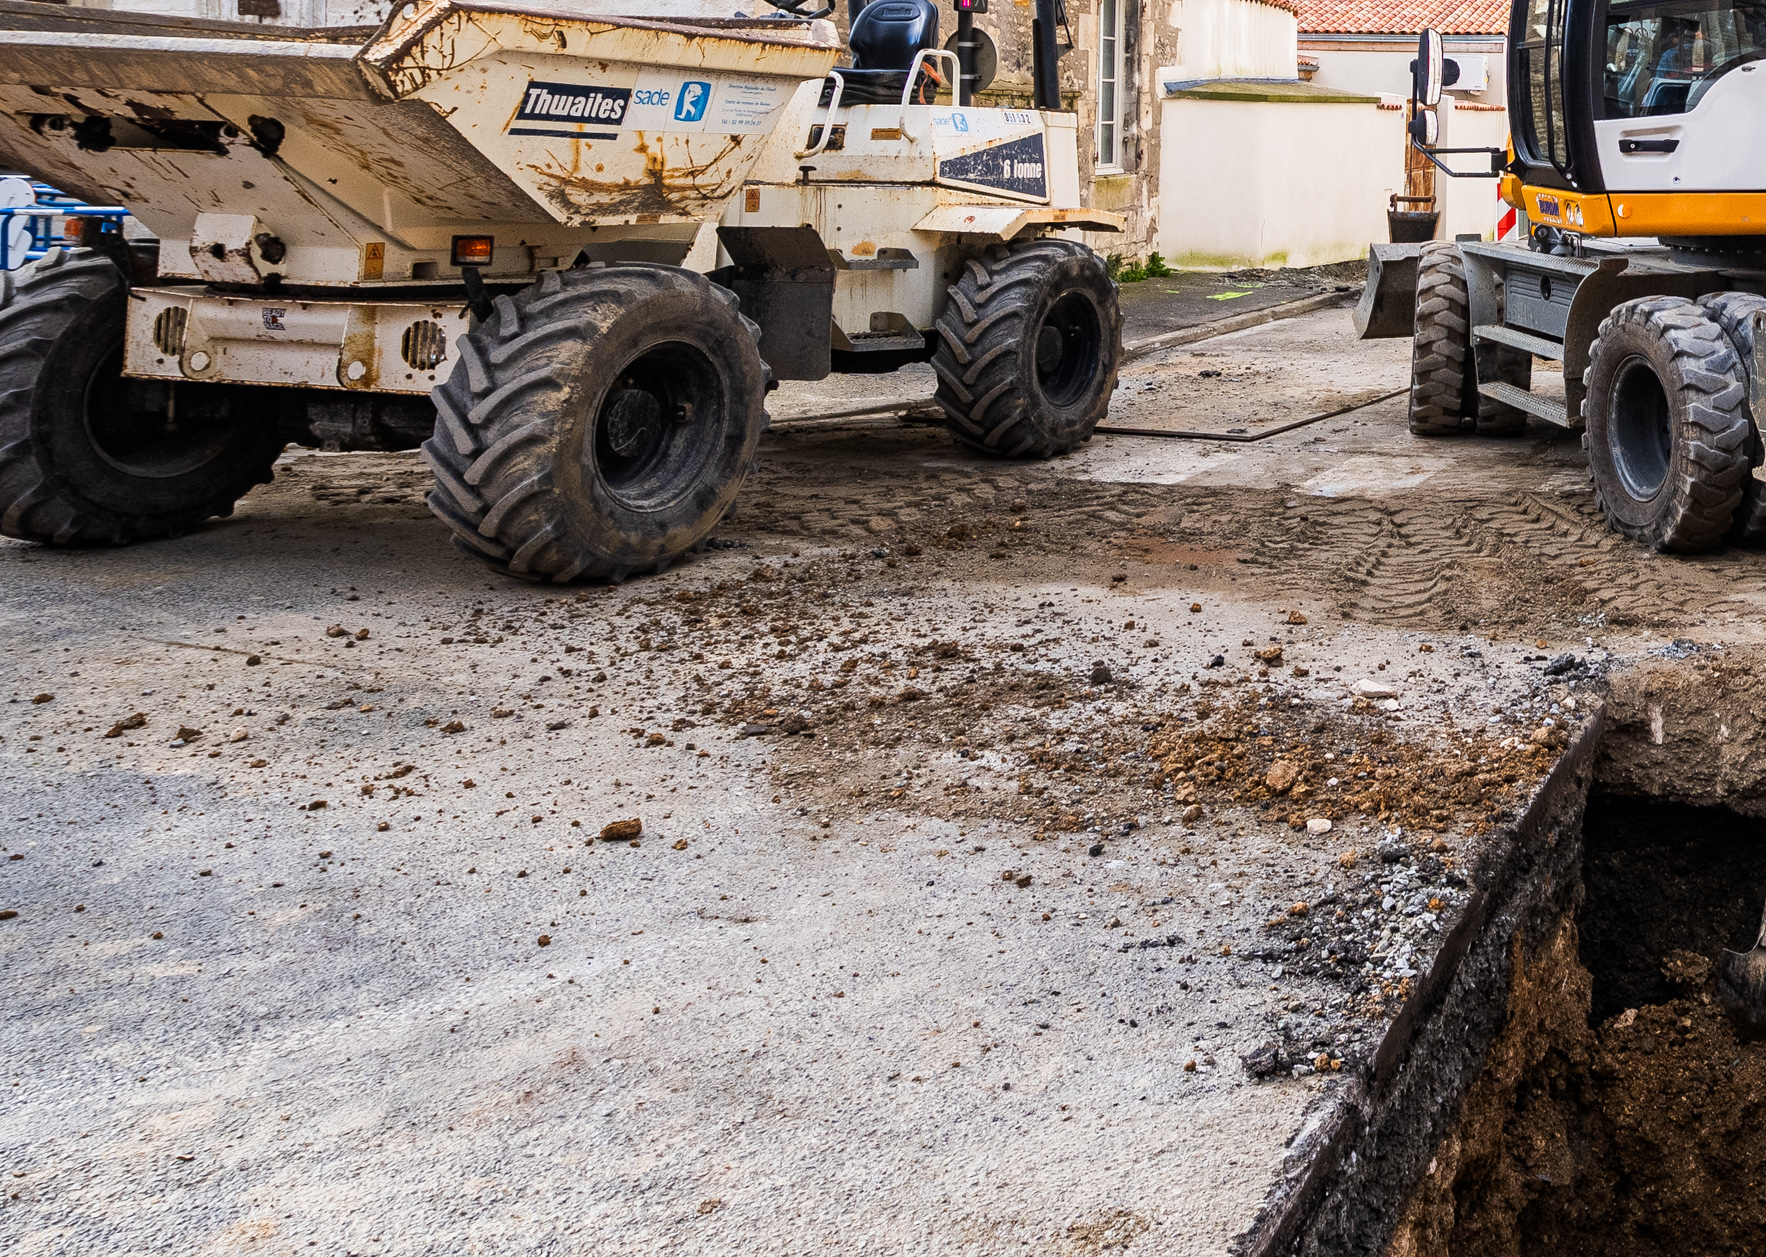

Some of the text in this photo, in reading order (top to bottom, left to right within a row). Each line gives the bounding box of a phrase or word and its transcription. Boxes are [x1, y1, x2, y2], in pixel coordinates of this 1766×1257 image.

[524, 88, 625, 120] Thwaites
[633, 89, 670, 106] sade
[1003, 159, 1042, 179] 6 tonne
